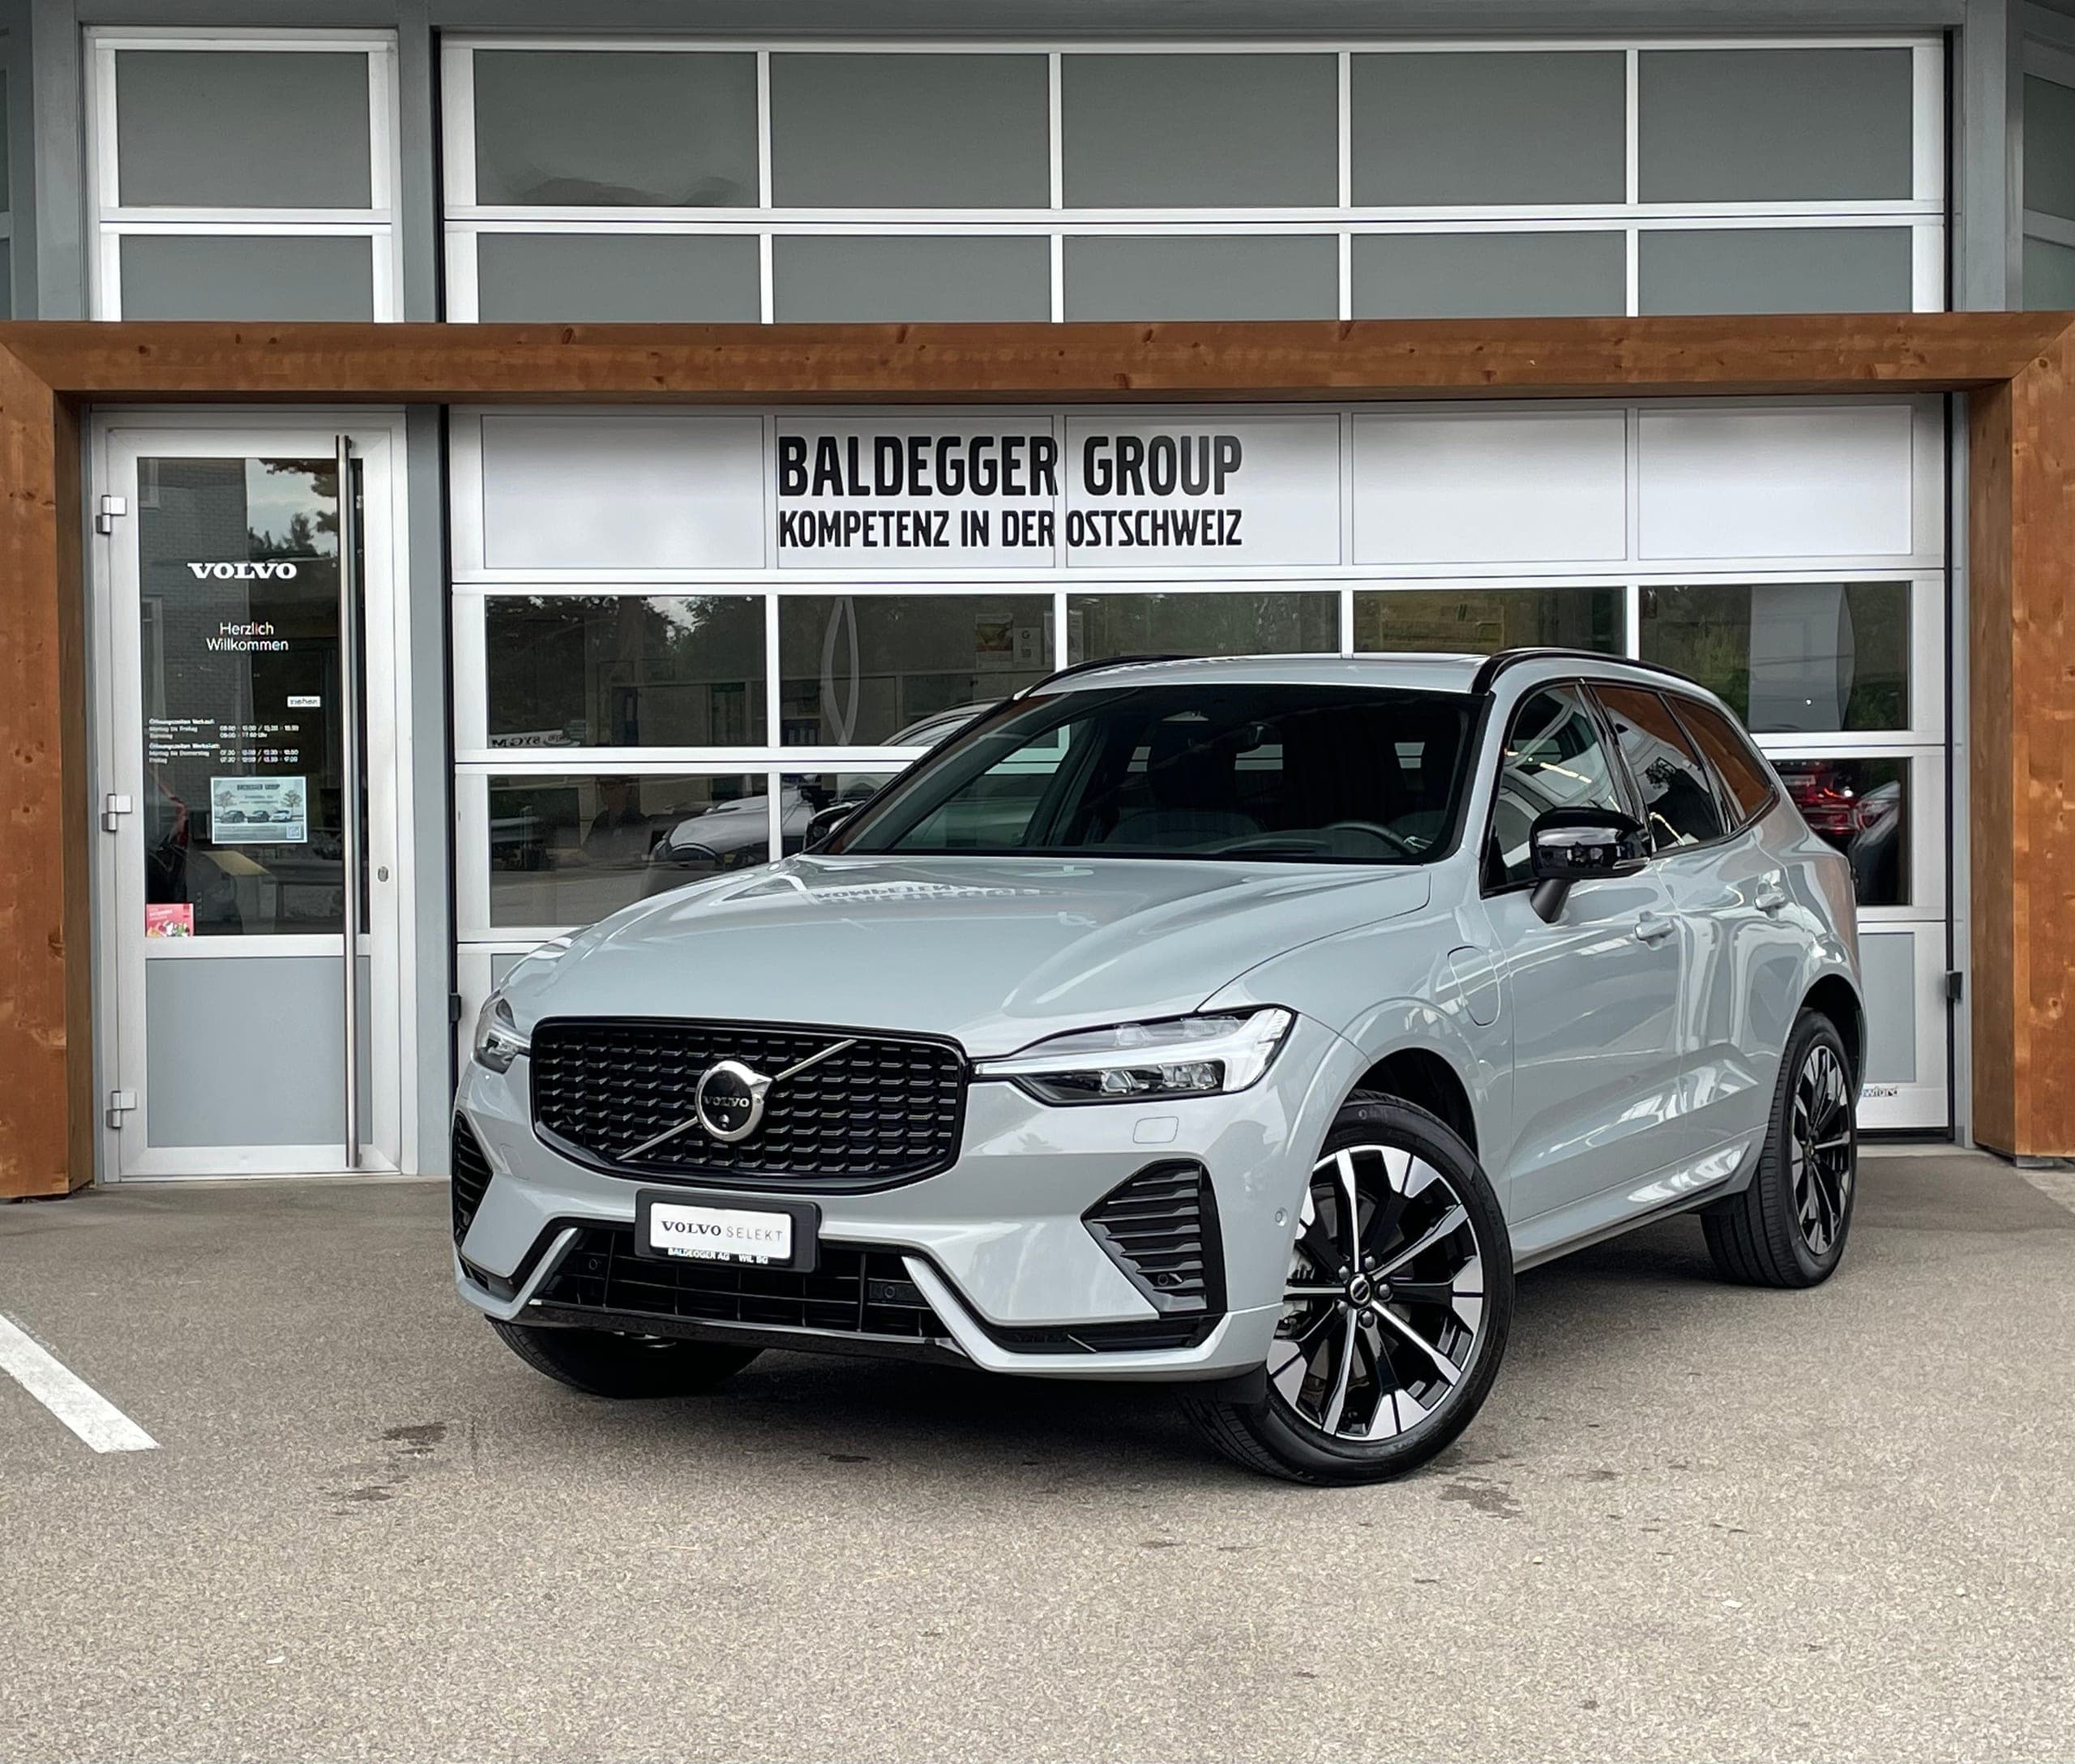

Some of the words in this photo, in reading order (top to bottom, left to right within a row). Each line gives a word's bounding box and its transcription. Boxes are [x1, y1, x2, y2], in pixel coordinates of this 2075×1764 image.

[778, 435, 1059, 497] BALDEGGER
[1083, 435, 1243, 496] GROUP
[778, 510, 949, 548] KOMPETENZ
[960, 510, 990, 547] IN
[1002, 510, 1055, 547] DER
[1067, 509, 1243, 547] OSTSCHWEIZ
[187, 563, 297, 579] VOLVO
[220, 622, 274, 635] Herzlich
[206, 637, 289, 651] Willkommen
[702, 1095, 750, 1107] VOLVO
[661, 1221, 721, 1236] VOLVO
[725, 1226, 784, 1242] SELEKT
